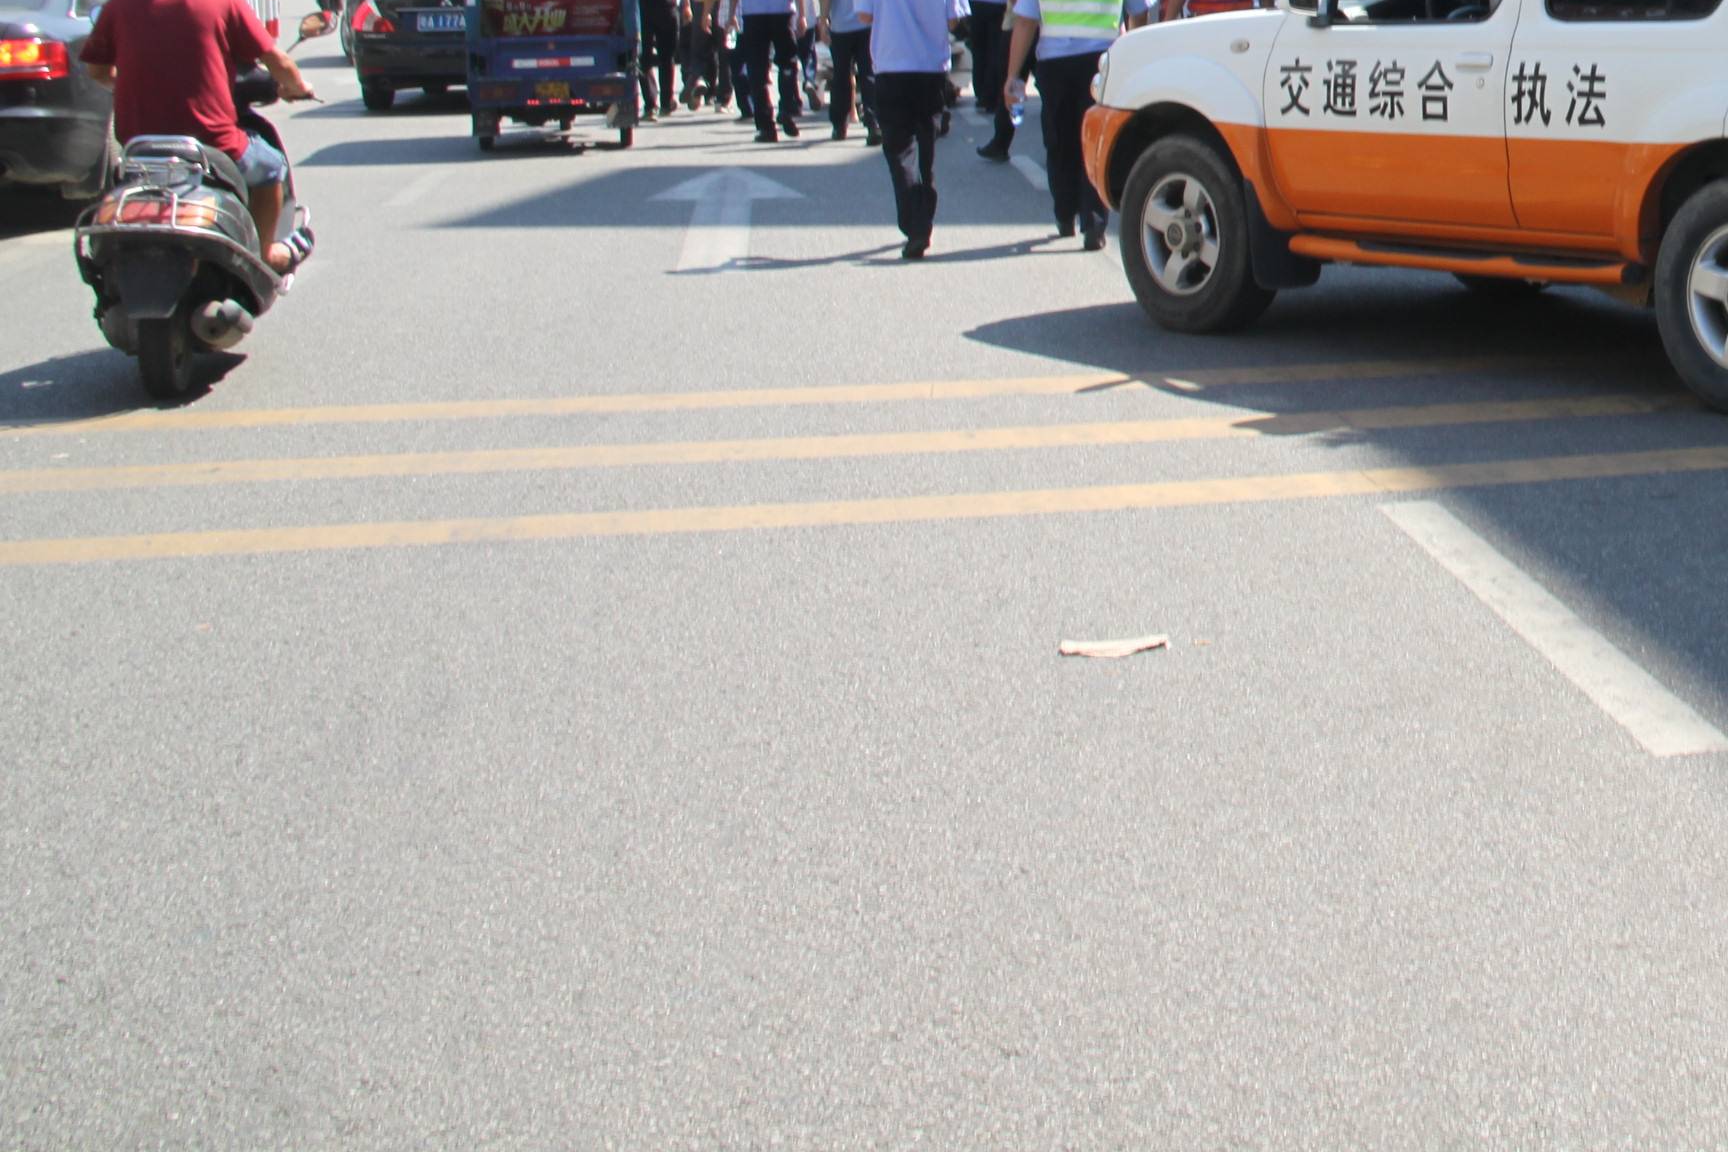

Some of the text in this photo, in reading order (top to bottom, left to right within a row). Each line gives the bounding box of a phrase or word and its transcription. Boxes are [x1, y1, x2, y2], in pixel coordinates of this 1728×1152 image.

[1280, 58, 1607, 127] 交通综合执法
